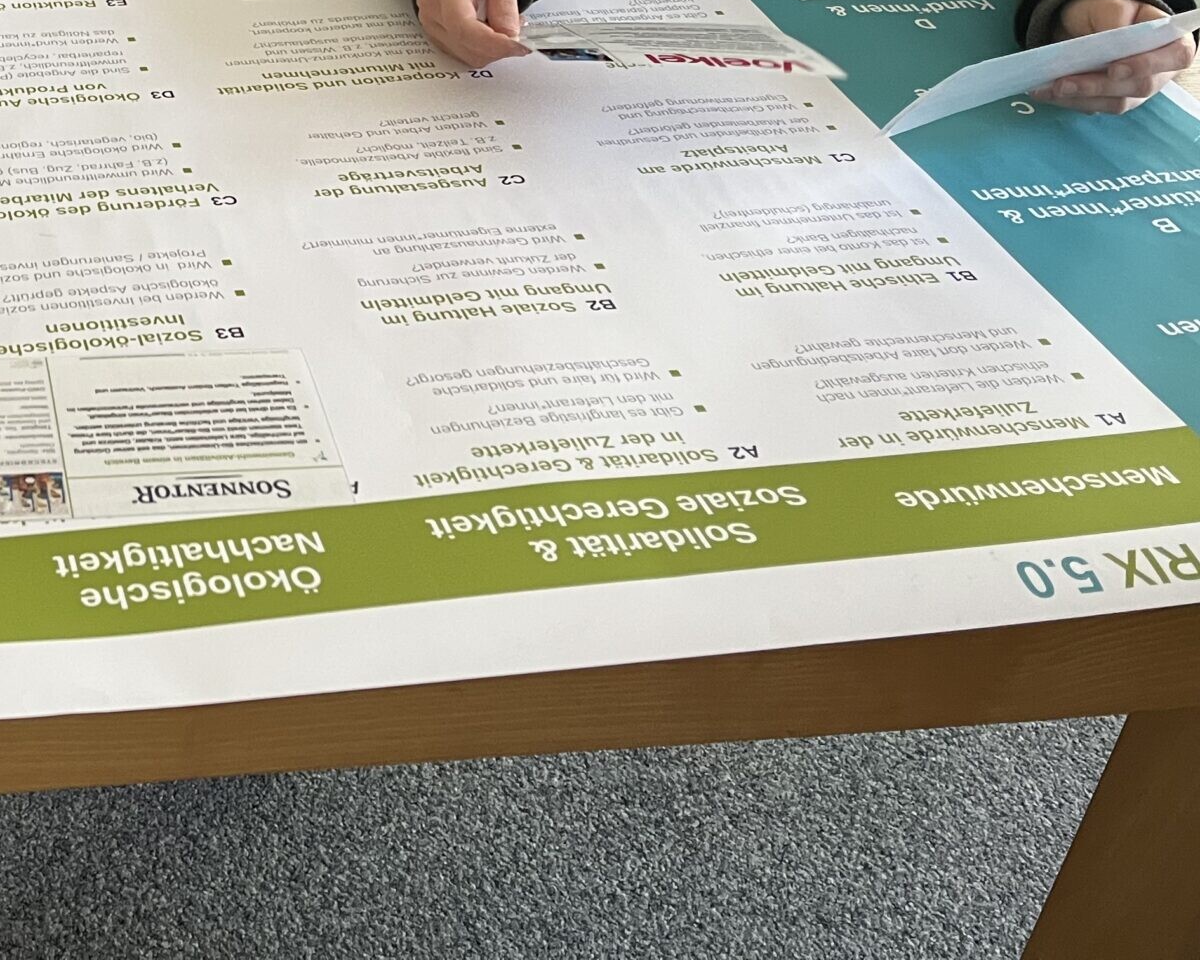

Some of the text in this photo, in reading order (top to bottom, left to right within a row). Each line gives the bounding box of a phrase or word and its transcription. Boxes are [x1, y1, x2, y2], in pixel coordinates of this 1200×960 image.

[11, 0, 97, 10] Reduktion
[106, 0, 128, 7] E3
[826, 6, 847, 17] &
[914, 18, 937, 30] D
[262, 62, 436, 80] mit Mitunternehmen
[74, 83, 108, 91] von
[217, 69, 494, 95] D2 Kooperation und Solidarität
[28, 93, 141, 106] Ökologische
[151, 90, 176, 100] D3
[1010, 101, 1035, 115] C
[680, 144, 788, 158] Arbeitsplatz
[338, 164, 482, 182] Arbeitsverträge
[637, 153, 856, 175] C1 Menschenwürde am
[79, 190, 110, 200] der
[116, 183, 220, 197] Verhaltens
[315, 175, 526, 199] C2 Ausgestaltung der
[97, 198, 201, 212] Förderung
[211, 196, 238, 207] C3
[56, 206, 92, 216] des
[998, 210, 1025, 224] &
[1151, 217, 1181, 234] B
[719, 255, 962, 284] Umgang mit Geldmitteln
[735, 271, 979, 298] B1 Ethische Haltung im
[360, 283, 612, 312] Umgang mit Geldmitteln
[381, 299, 617, 327] B2 Soziale Haltung im
[46, 314, 185, 334] Investitionen
[215, 327, 245, 340] B3
[898, 401, 1038, 422] Zulieferkette
[838, 412, 1127, 450] A1 Menschenwürde in der
[471, 432, 686, 458] in der Zulieferkette
[414, 445, 759, 488] A2 Solidarität & Gerechtigkeit
[895, 466, 1181, 511] Menschenwürde
[425, 486, 807, 540] Soziale Gerechtigkeit
[528, 523, 758, 562] Solidarität &
[52, 531, 326, 579] Nachhaltigkeit
[1016, 556, 1104, 598] 5.0
[80, 566, 321, 610] Ökologische
